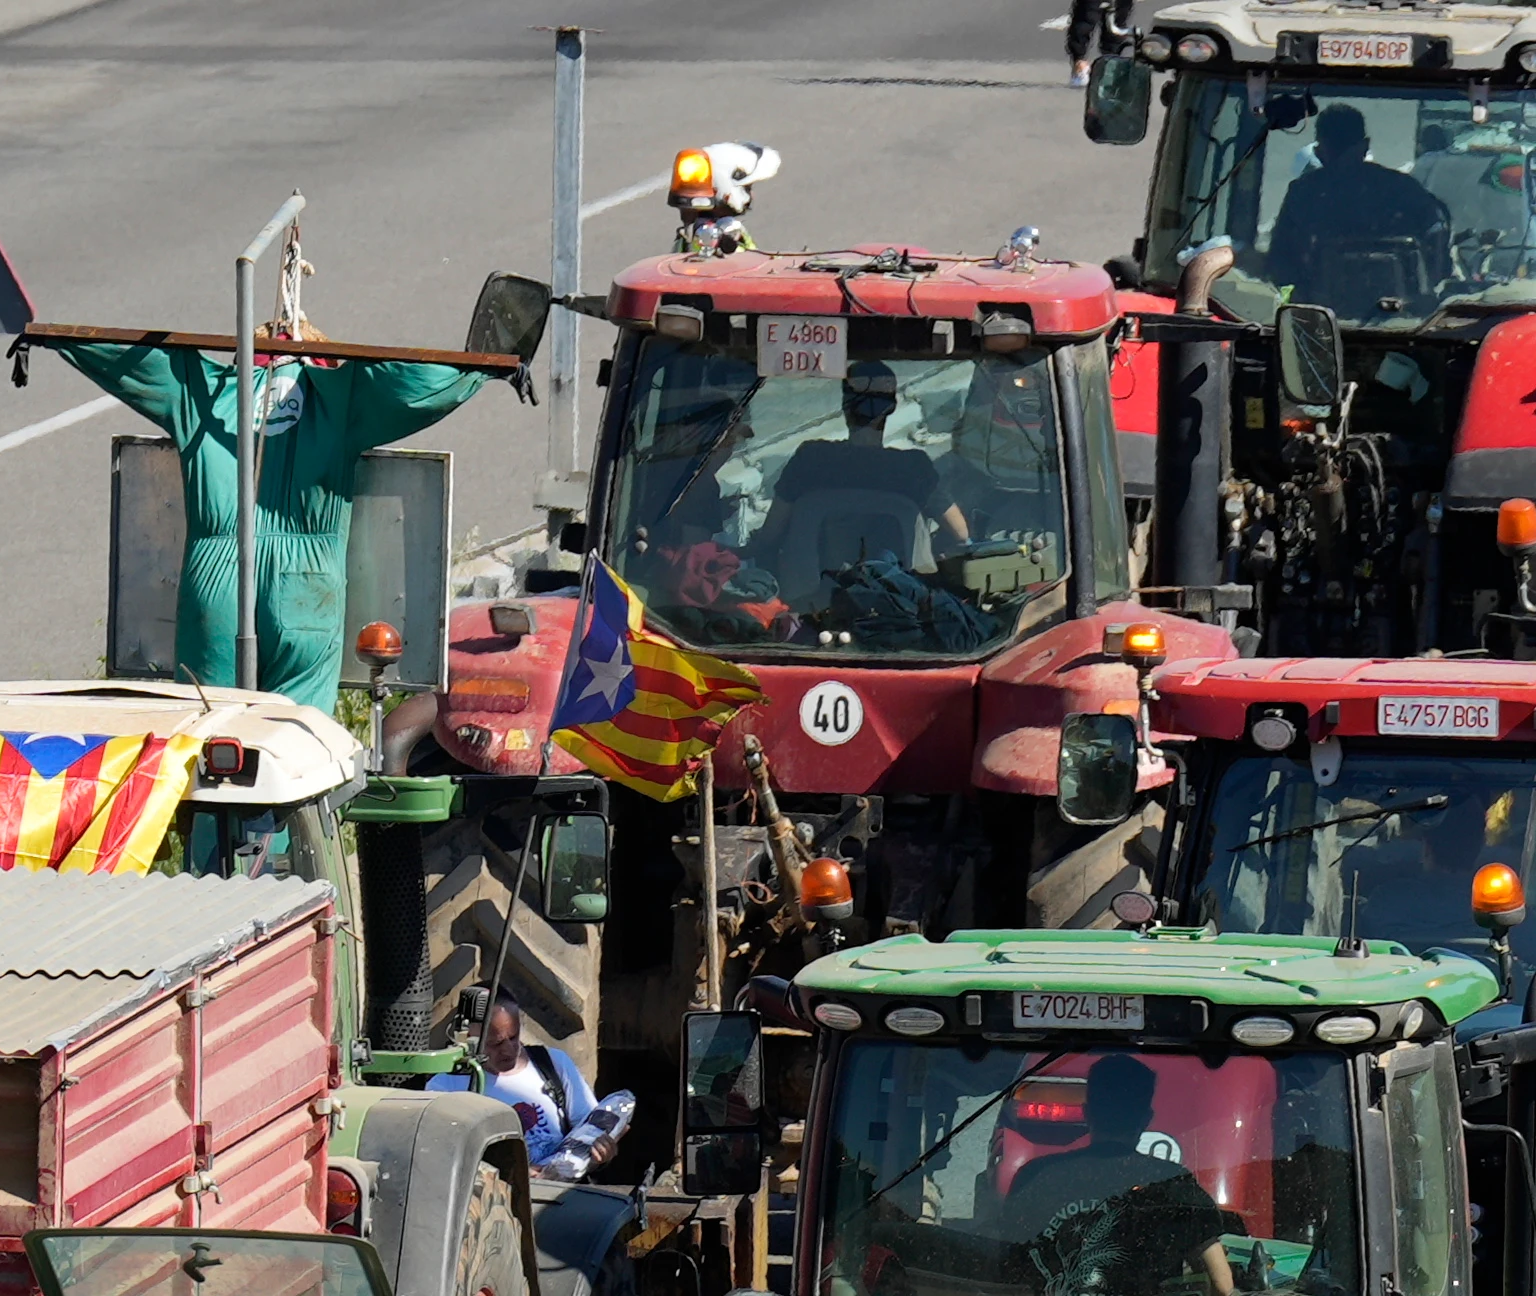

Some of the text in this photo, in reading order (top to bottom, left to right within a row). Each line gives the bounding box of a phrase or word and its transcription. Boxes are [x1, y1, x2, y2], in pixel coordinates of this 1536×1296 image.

[767, 323, 838, 345] E 4960
[783, 351, 823, 371] BDX
[813, 694, 850, 733] 40
[1043, 1199, 1109, 1241] REVOLTA
